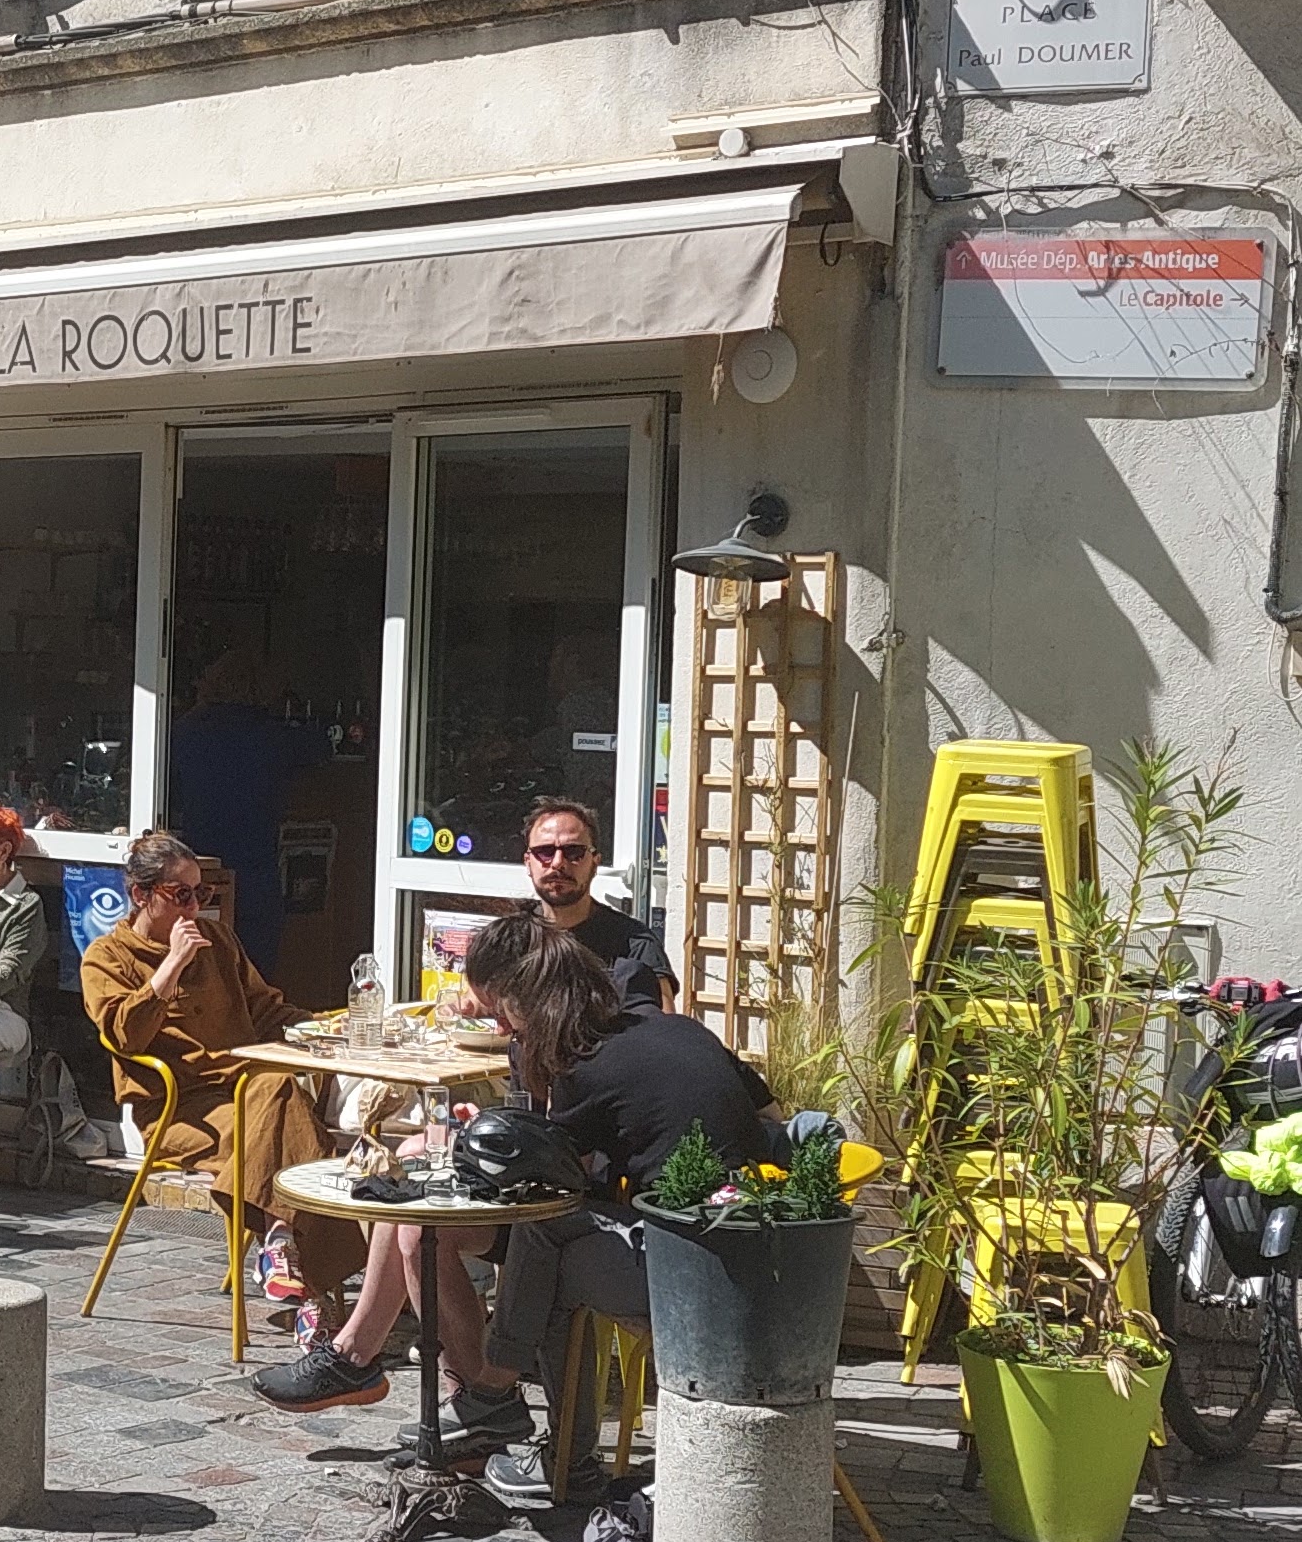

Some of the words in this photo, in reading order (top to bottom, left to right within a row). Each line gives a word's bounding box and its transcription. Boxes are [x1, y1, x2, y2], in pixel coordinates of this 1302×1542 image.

[1001, 2, 1097, 24] PLACE
[958, 49, 1002, 68] Paul
[1017, 42, 1134, 64] DOUMER
[981, 251, 1037, 269] Musée
[1043, 251, 1081, 272] Dép.
[1140, 250, 1219, 272] Antique
[1119, 289, 1138, 307] Le
[1142, 288, 1225, 310] Capitole
[61, 296, 314, 373] ROQUETTE
